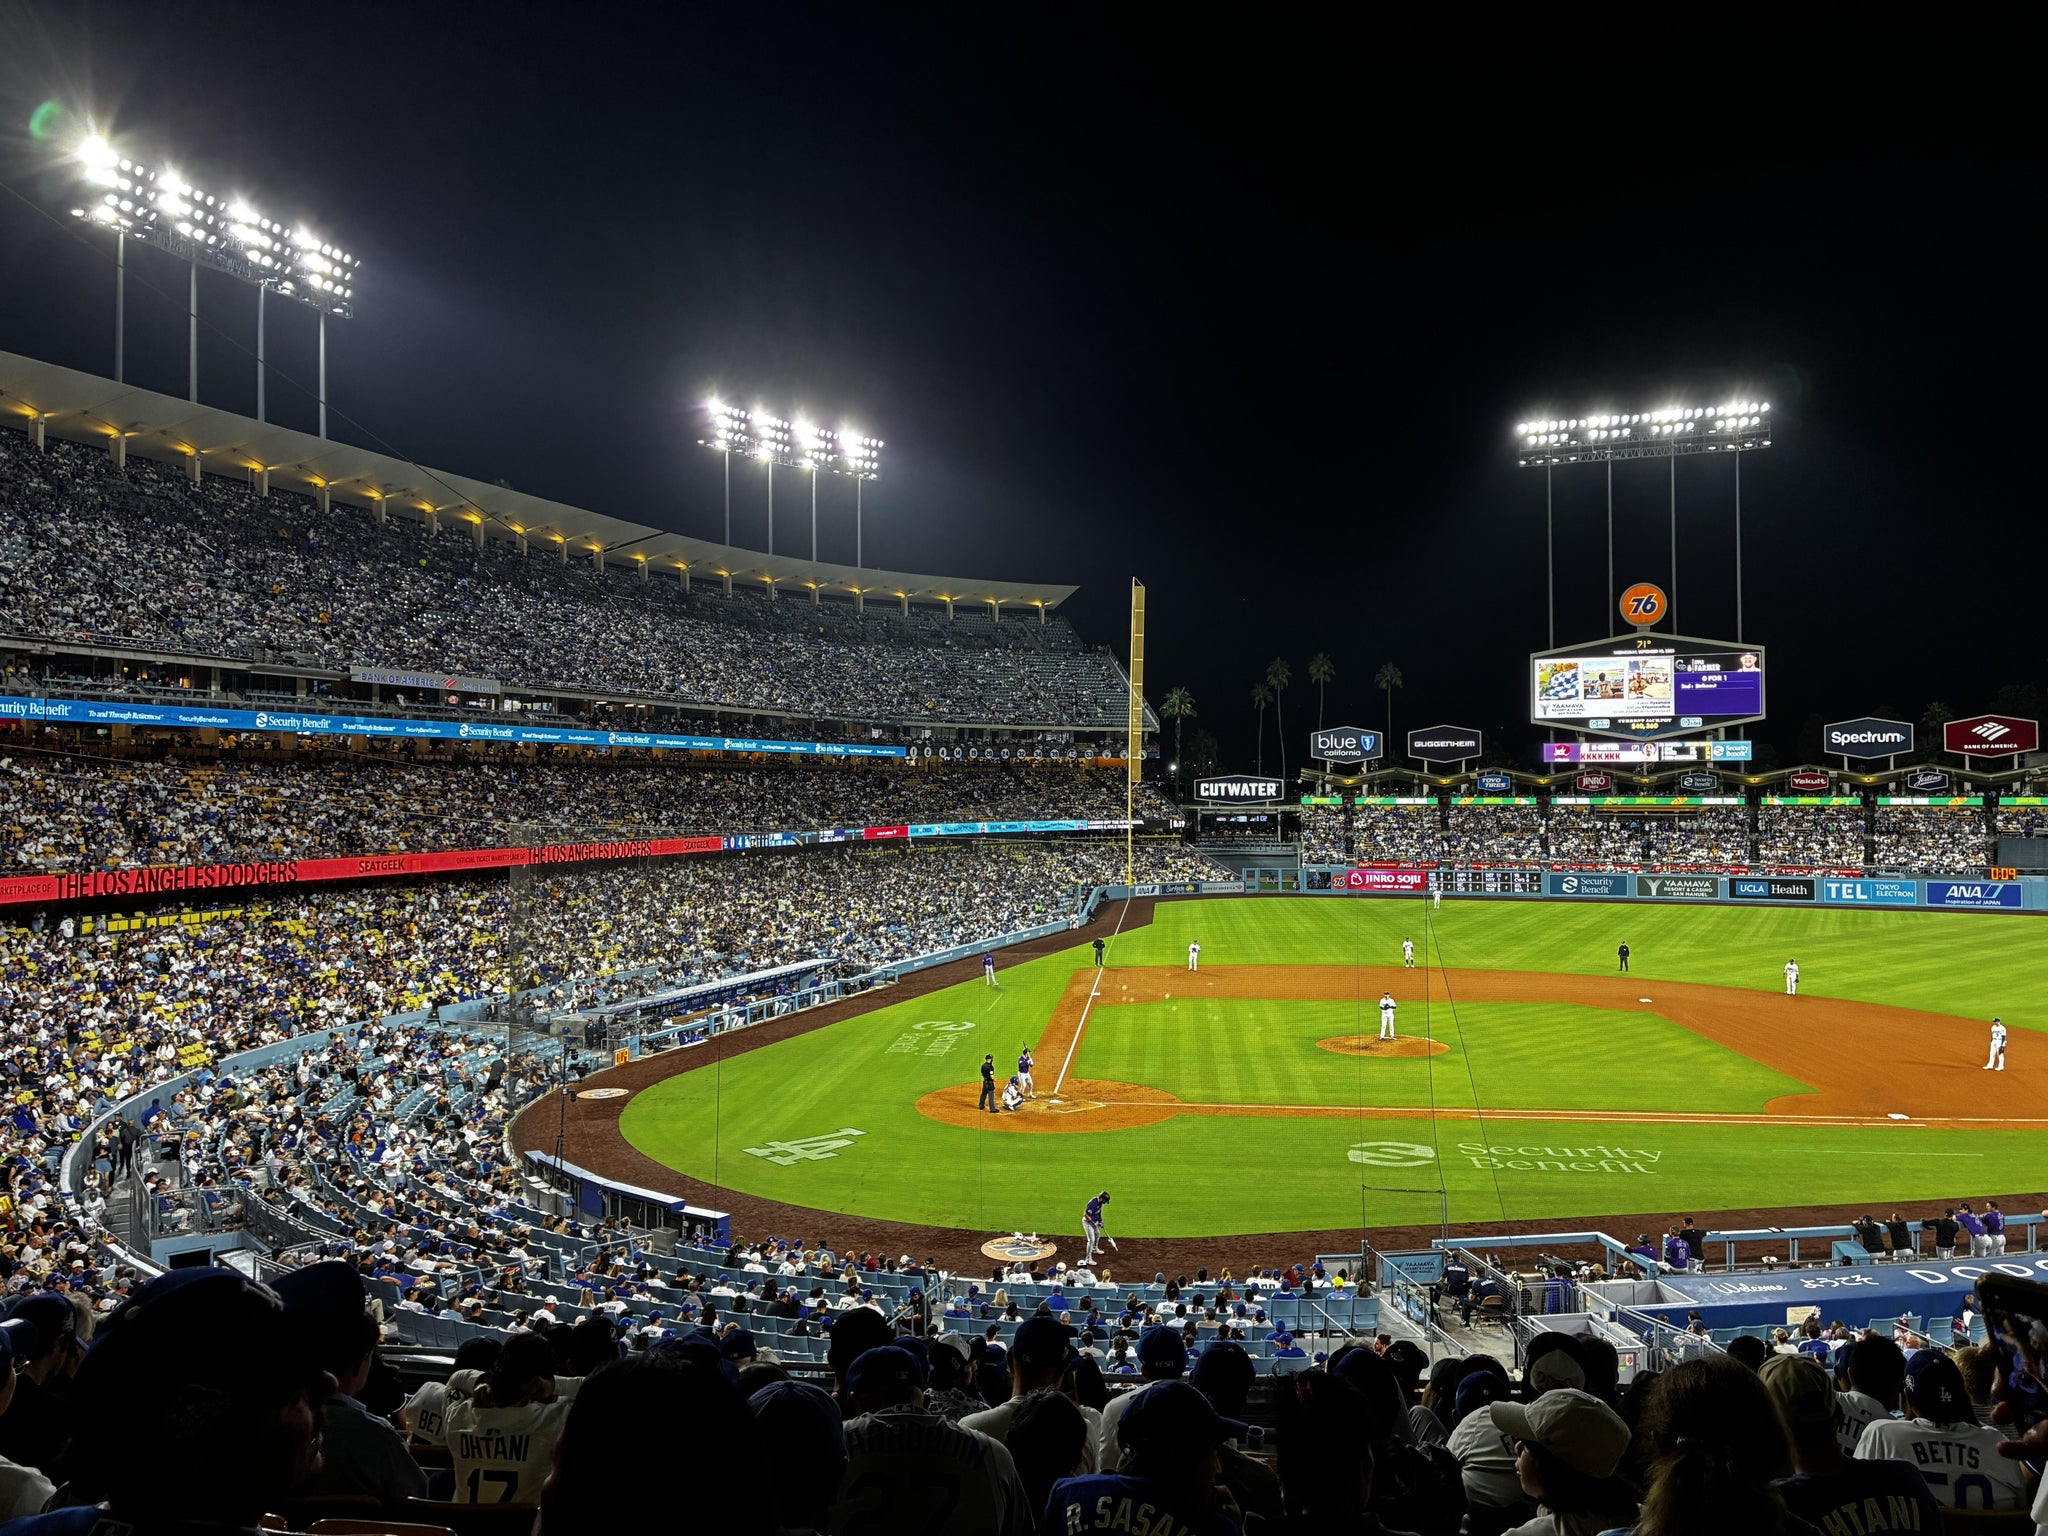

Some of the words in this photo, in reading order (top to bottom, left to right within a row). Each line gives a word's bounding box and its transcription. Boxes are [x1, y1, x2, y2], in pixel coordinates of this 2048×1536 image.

[1628, 592, 1659, 616] 76
[1694, 663, 1721, 672] FARMER
[360, 671, 387, 684] BANK
[388, 674, 400, 685] OF
[400, 675, 440, 688] AMERICA
[268, 716, 301, 729] Security
[302, 717, 330, 729] Benefit
[468, 728, 492, 737] Security
[492, 728, 513, 738] Benefit
[615, 734, 633, 744] Security
[1831, 731, 1902, 746] Spectrum
[1317, 734, 1357, 750] blue
[1414, 740, 1476, 748] GUGGENHEIM
[1725, 744, 1749, 753] Security
[1323, 749, 1361, 757] california
[1582, 777, 1605, 786] JINRO
[1694, 776, 1713, 784] Security
[1793, 777, 1827, 785] Yakult
[1200, 783, 1277, 797] CUTWATER
[548, 845, 567, 863] LOS
[568, 841, 610, 862] ANGELES
[610, 841, 651, 859] DODGERS
[358, 858, 406, 873] SEATGEEK
[55, 873, 90, 899] THE
[92, 870, 131, 896] LOS
[133, 865, 217, 893] ANGELES
[218, 861, 298, 888] DODGERS
[1365, 874, 1397, 884] JINRO
[1398, 874, 1422, 885] SOJU
[1991, 867, 2017, 880] 0:09
[1333, 877, 1345, 886] 76
[1580, 877, 1614, 887] Security
[1136, 887, 1150, 895] ANA
[1581, 885, 1610, 894] Benefit
[1739, 883, 1765, 893] UCLA
[1771, 884, 1808, 895] Health
[1826, 883, 1868, 899] TEL
[1875, 890, 1914, 898] ELECTRON
[1946, 885, 1982, 898] ANA
[1945, 898, 1974, 906] Inspiration
[1456, 1142, 1663, 1163] Security
[1467, 1156, 1657, 1175] Benefit
[1709, 1282, 1788, 1296] Welcome
[459, 1432, 531, 1462] OHTANI
[1911, 1441, 1980, 1469] BETTS
[466, 1468, 519, 1504] 17
[1066, 1503, 1089, 1534] R.
